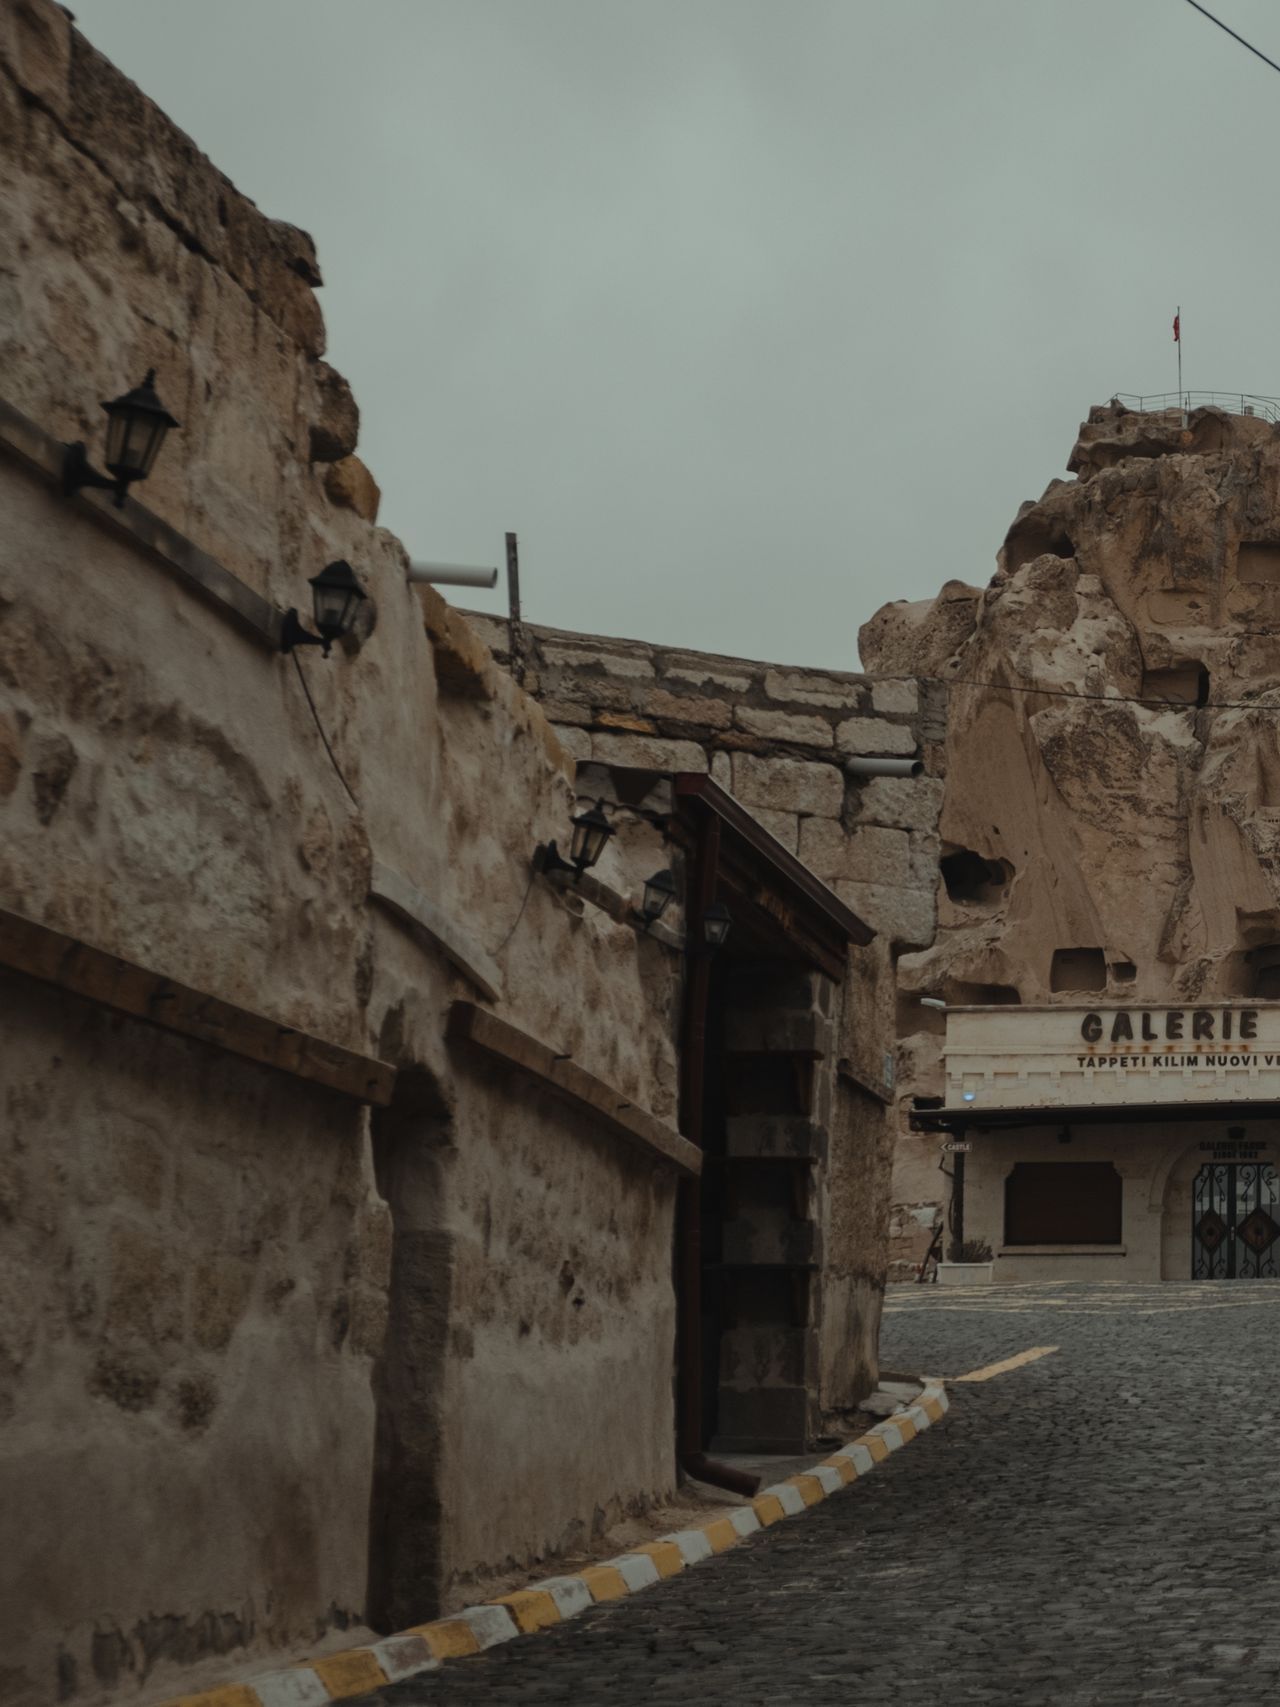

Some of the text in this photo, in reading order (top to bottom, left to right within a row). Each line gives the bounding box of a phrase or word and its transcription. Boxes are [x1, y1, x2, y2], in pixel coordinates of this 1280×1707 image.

[1081, 1010, 1259, 1042] GALERIE
[1077, 1056, 1146, 1068] TAPPETI
[1153, 1055, 1198, 1067] KILIM
[1205, 1055, 1257, 1066] NUOVI
[947, 1143, 970, 1151] CASTLE
